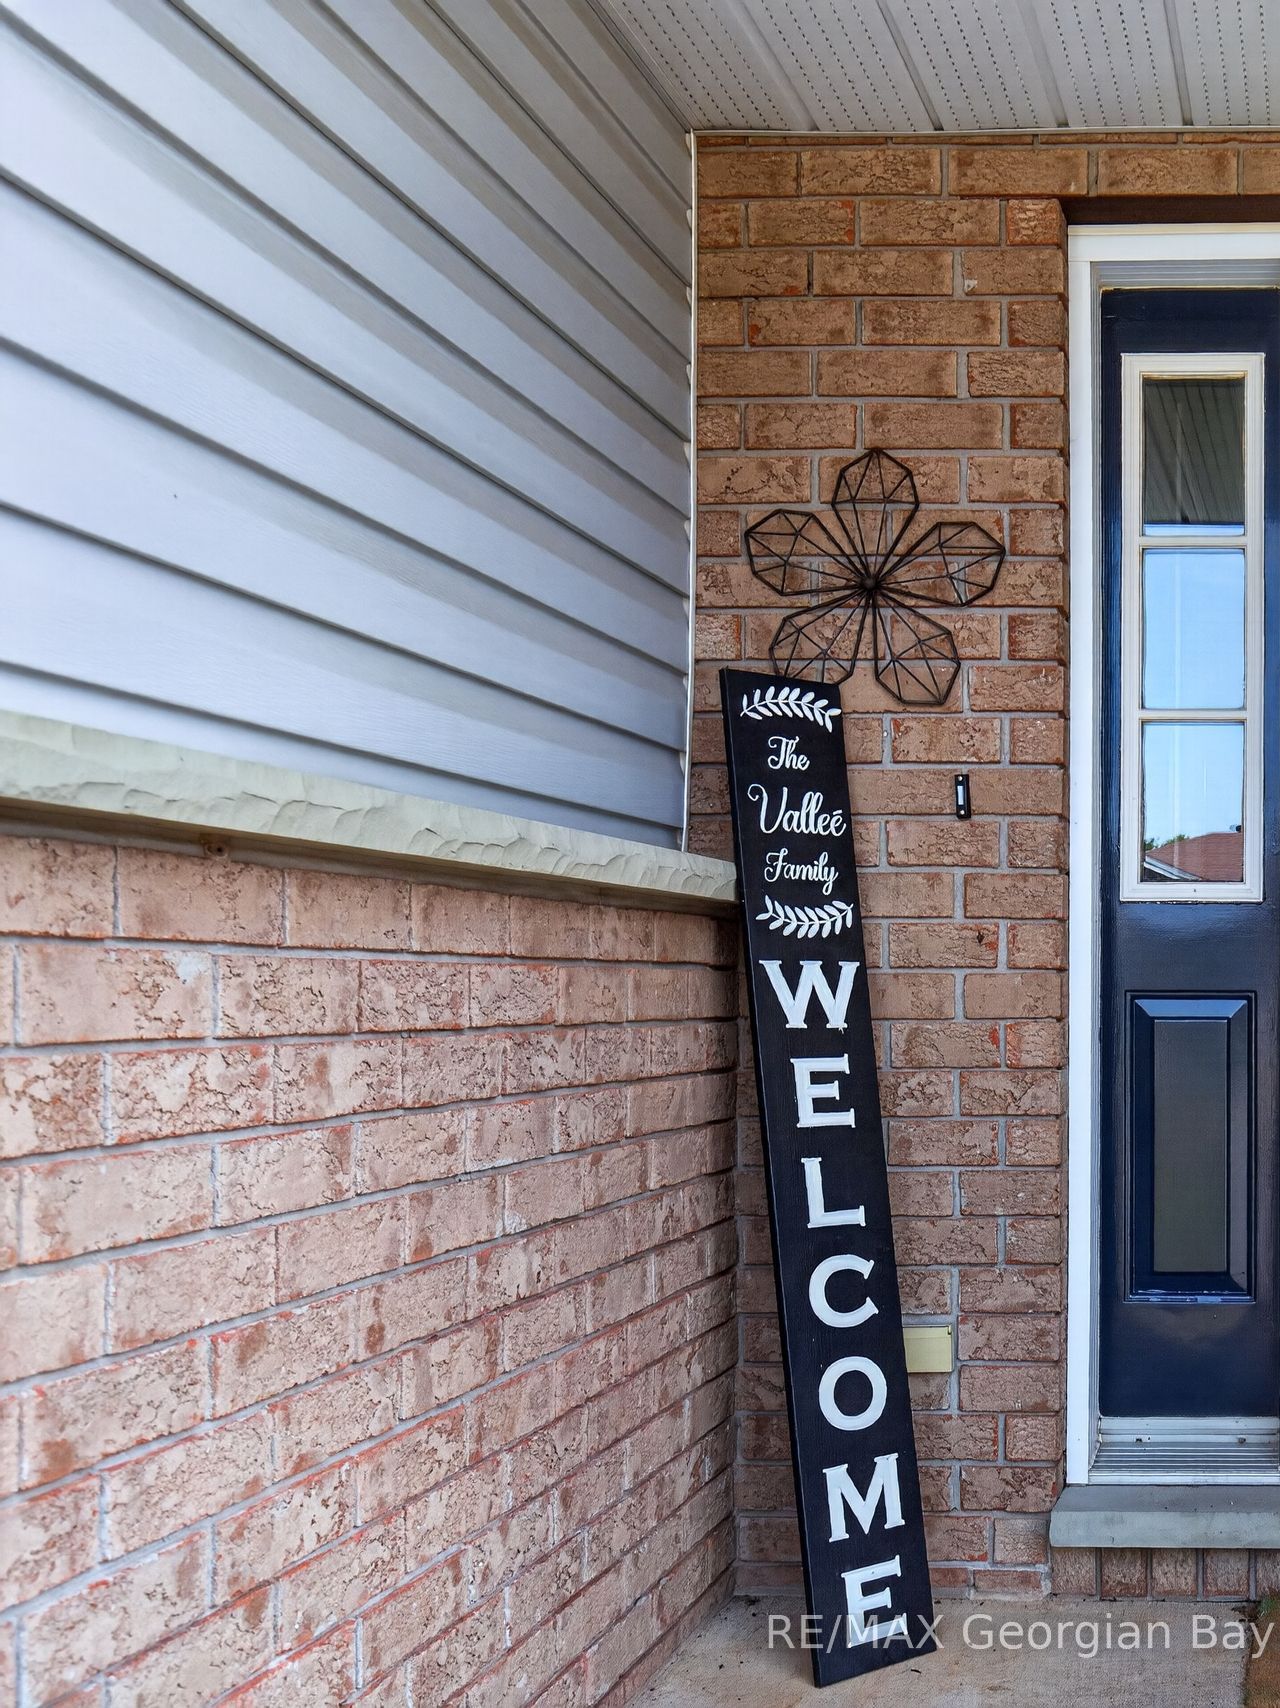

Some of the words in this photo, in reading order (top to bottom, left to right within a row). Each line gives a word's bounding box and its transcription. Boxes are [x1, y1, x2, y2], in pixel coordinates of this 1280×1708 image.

[767, 735, 810, 771] The
[747, 783, 847, 837] Valleé
[764, 847, 839, 896] Family
[758, 960, 909, 1649] WELCOME
